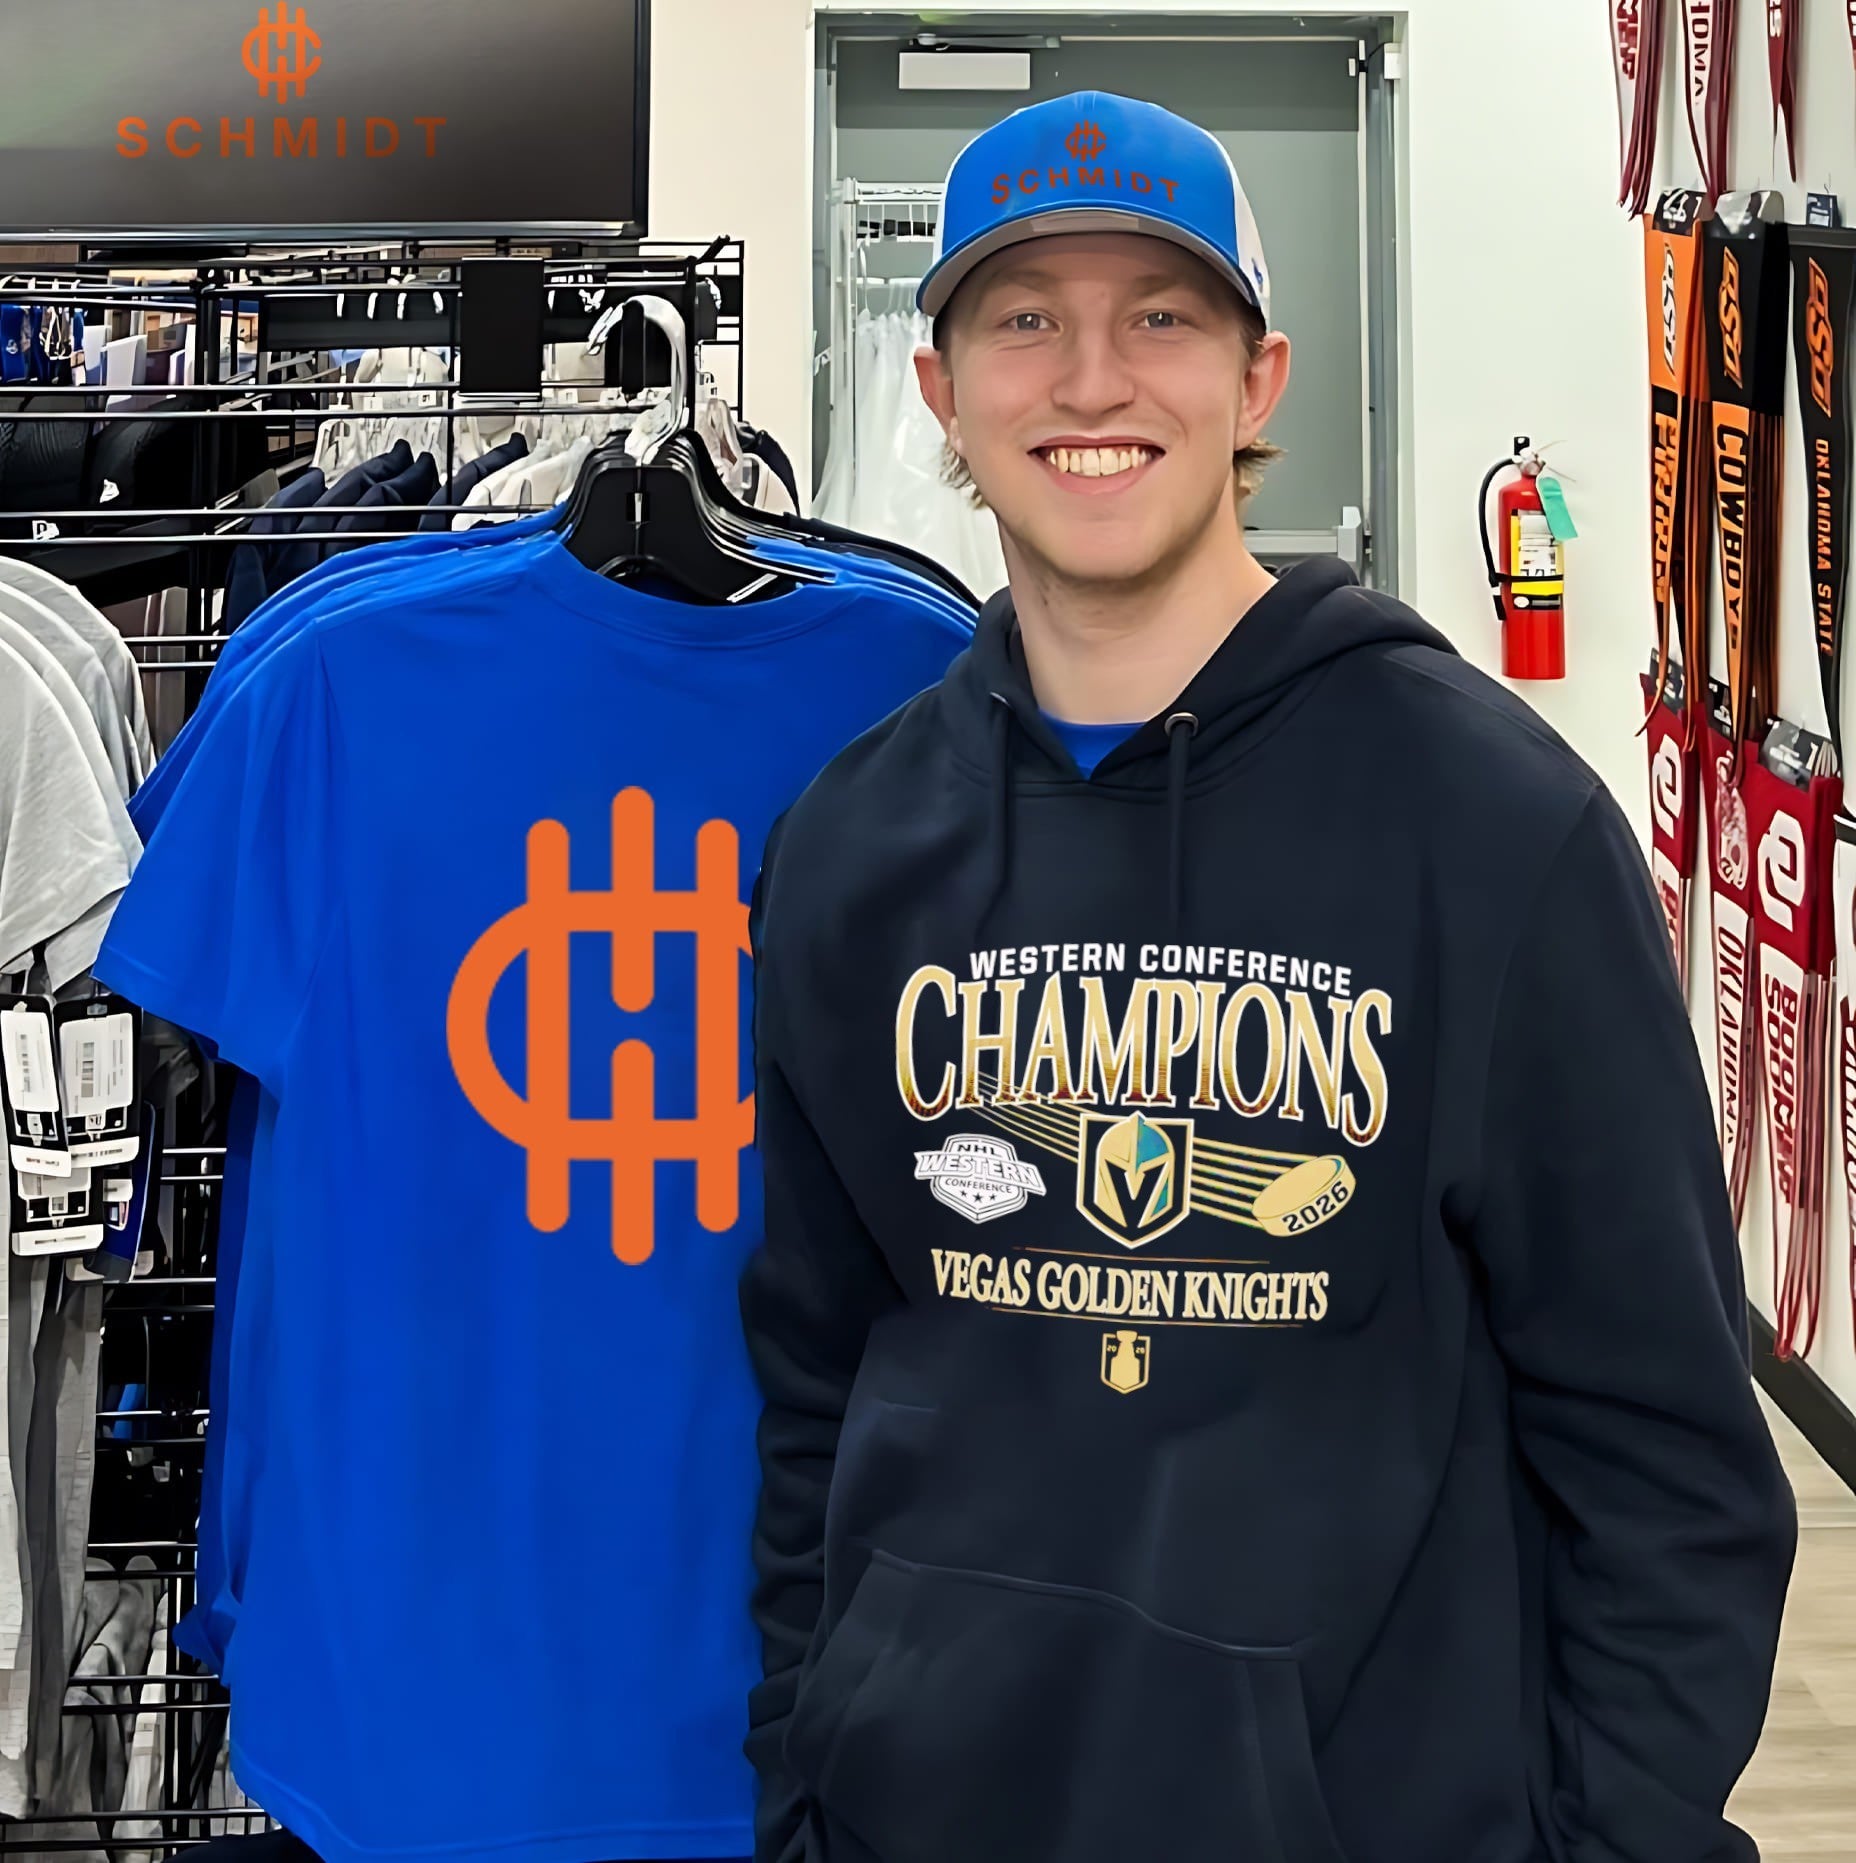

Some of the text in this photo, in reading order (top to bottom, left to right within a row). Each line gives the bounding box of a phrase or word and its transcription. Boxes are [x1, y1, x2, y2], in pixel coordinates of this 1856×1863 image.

[116, 116, 447, 158] SCHMIDT
[991, 167, 1179, 204] SCHMIDT
[971, 943, 1352, 997] WESTERN CONFERENCE
[896, 964, 1393, 1147] CHAMPIONS
[918, 1153, 1041, 1188] WESTERN
[957, 1144, 1003, 1158] NHL
[945, 1177, 1012, 1194] CONFERENCE
[1282, 1180, 1349, 1233] 2026
[931, 1248, 1330, 1322] VEGAS GOLDEN KNIGHTS
